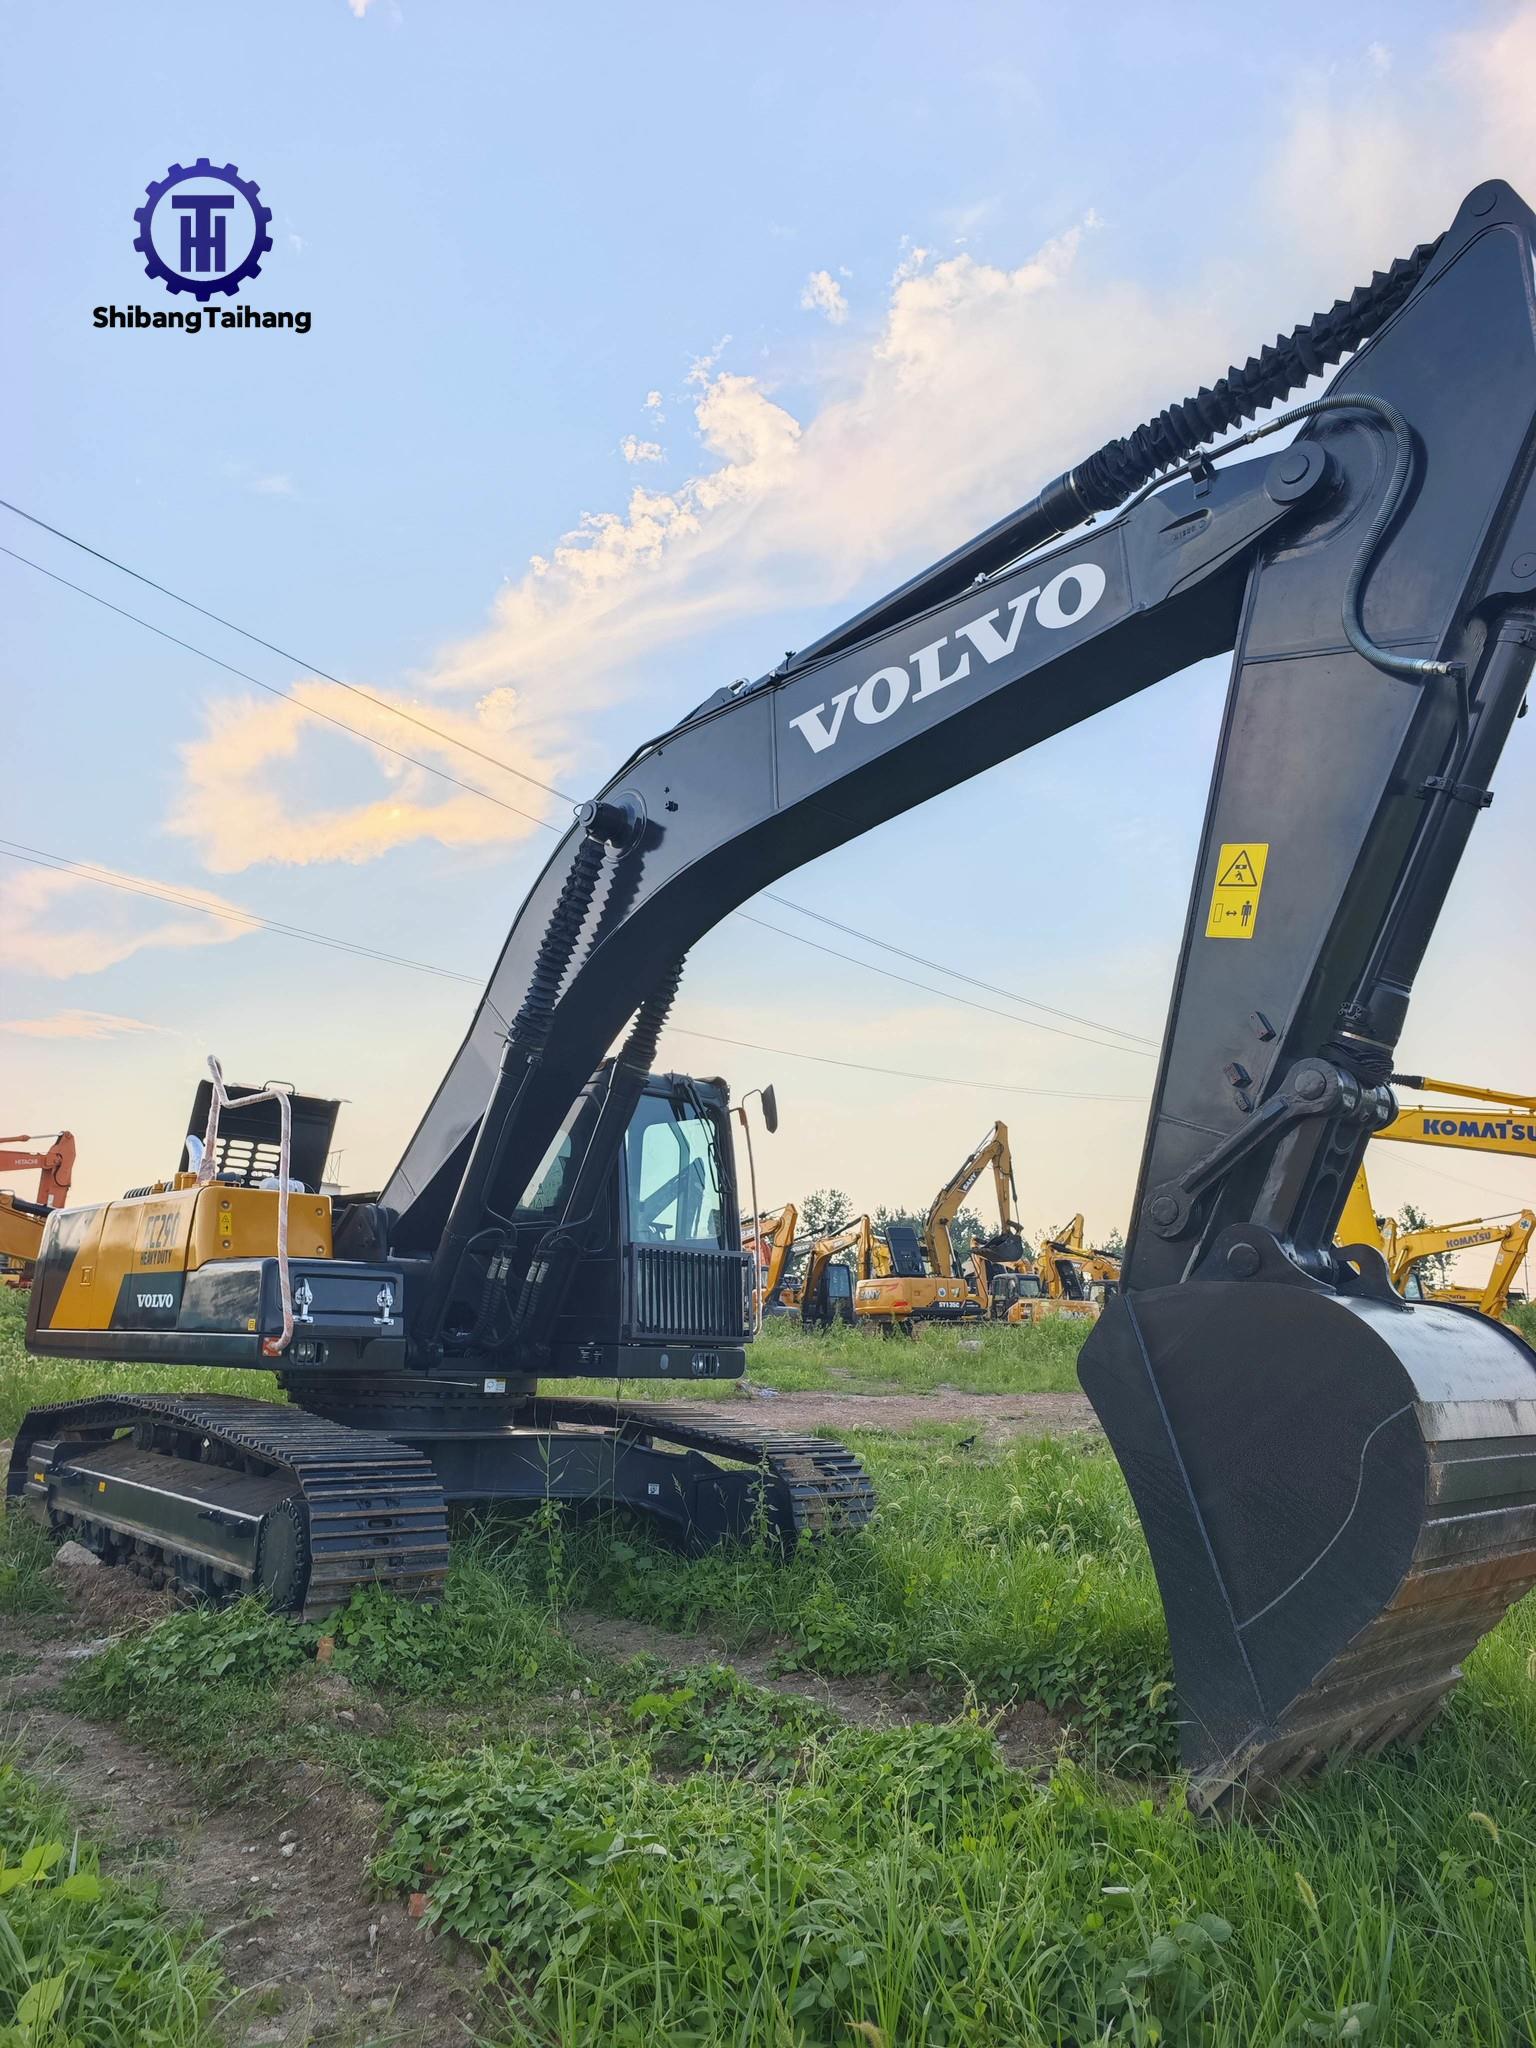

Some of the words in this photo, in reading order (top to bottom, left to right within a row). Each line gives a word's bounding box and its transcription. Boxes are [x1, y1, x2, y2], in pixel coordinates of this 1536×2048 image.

[789, 562, 1107, 754] VOLVO
[962, 1172, 977, 1190] SANY
[1446, 1232, 1491, 1248] KOMATSU
[136, 1294, 174, 1308] VOLVO
